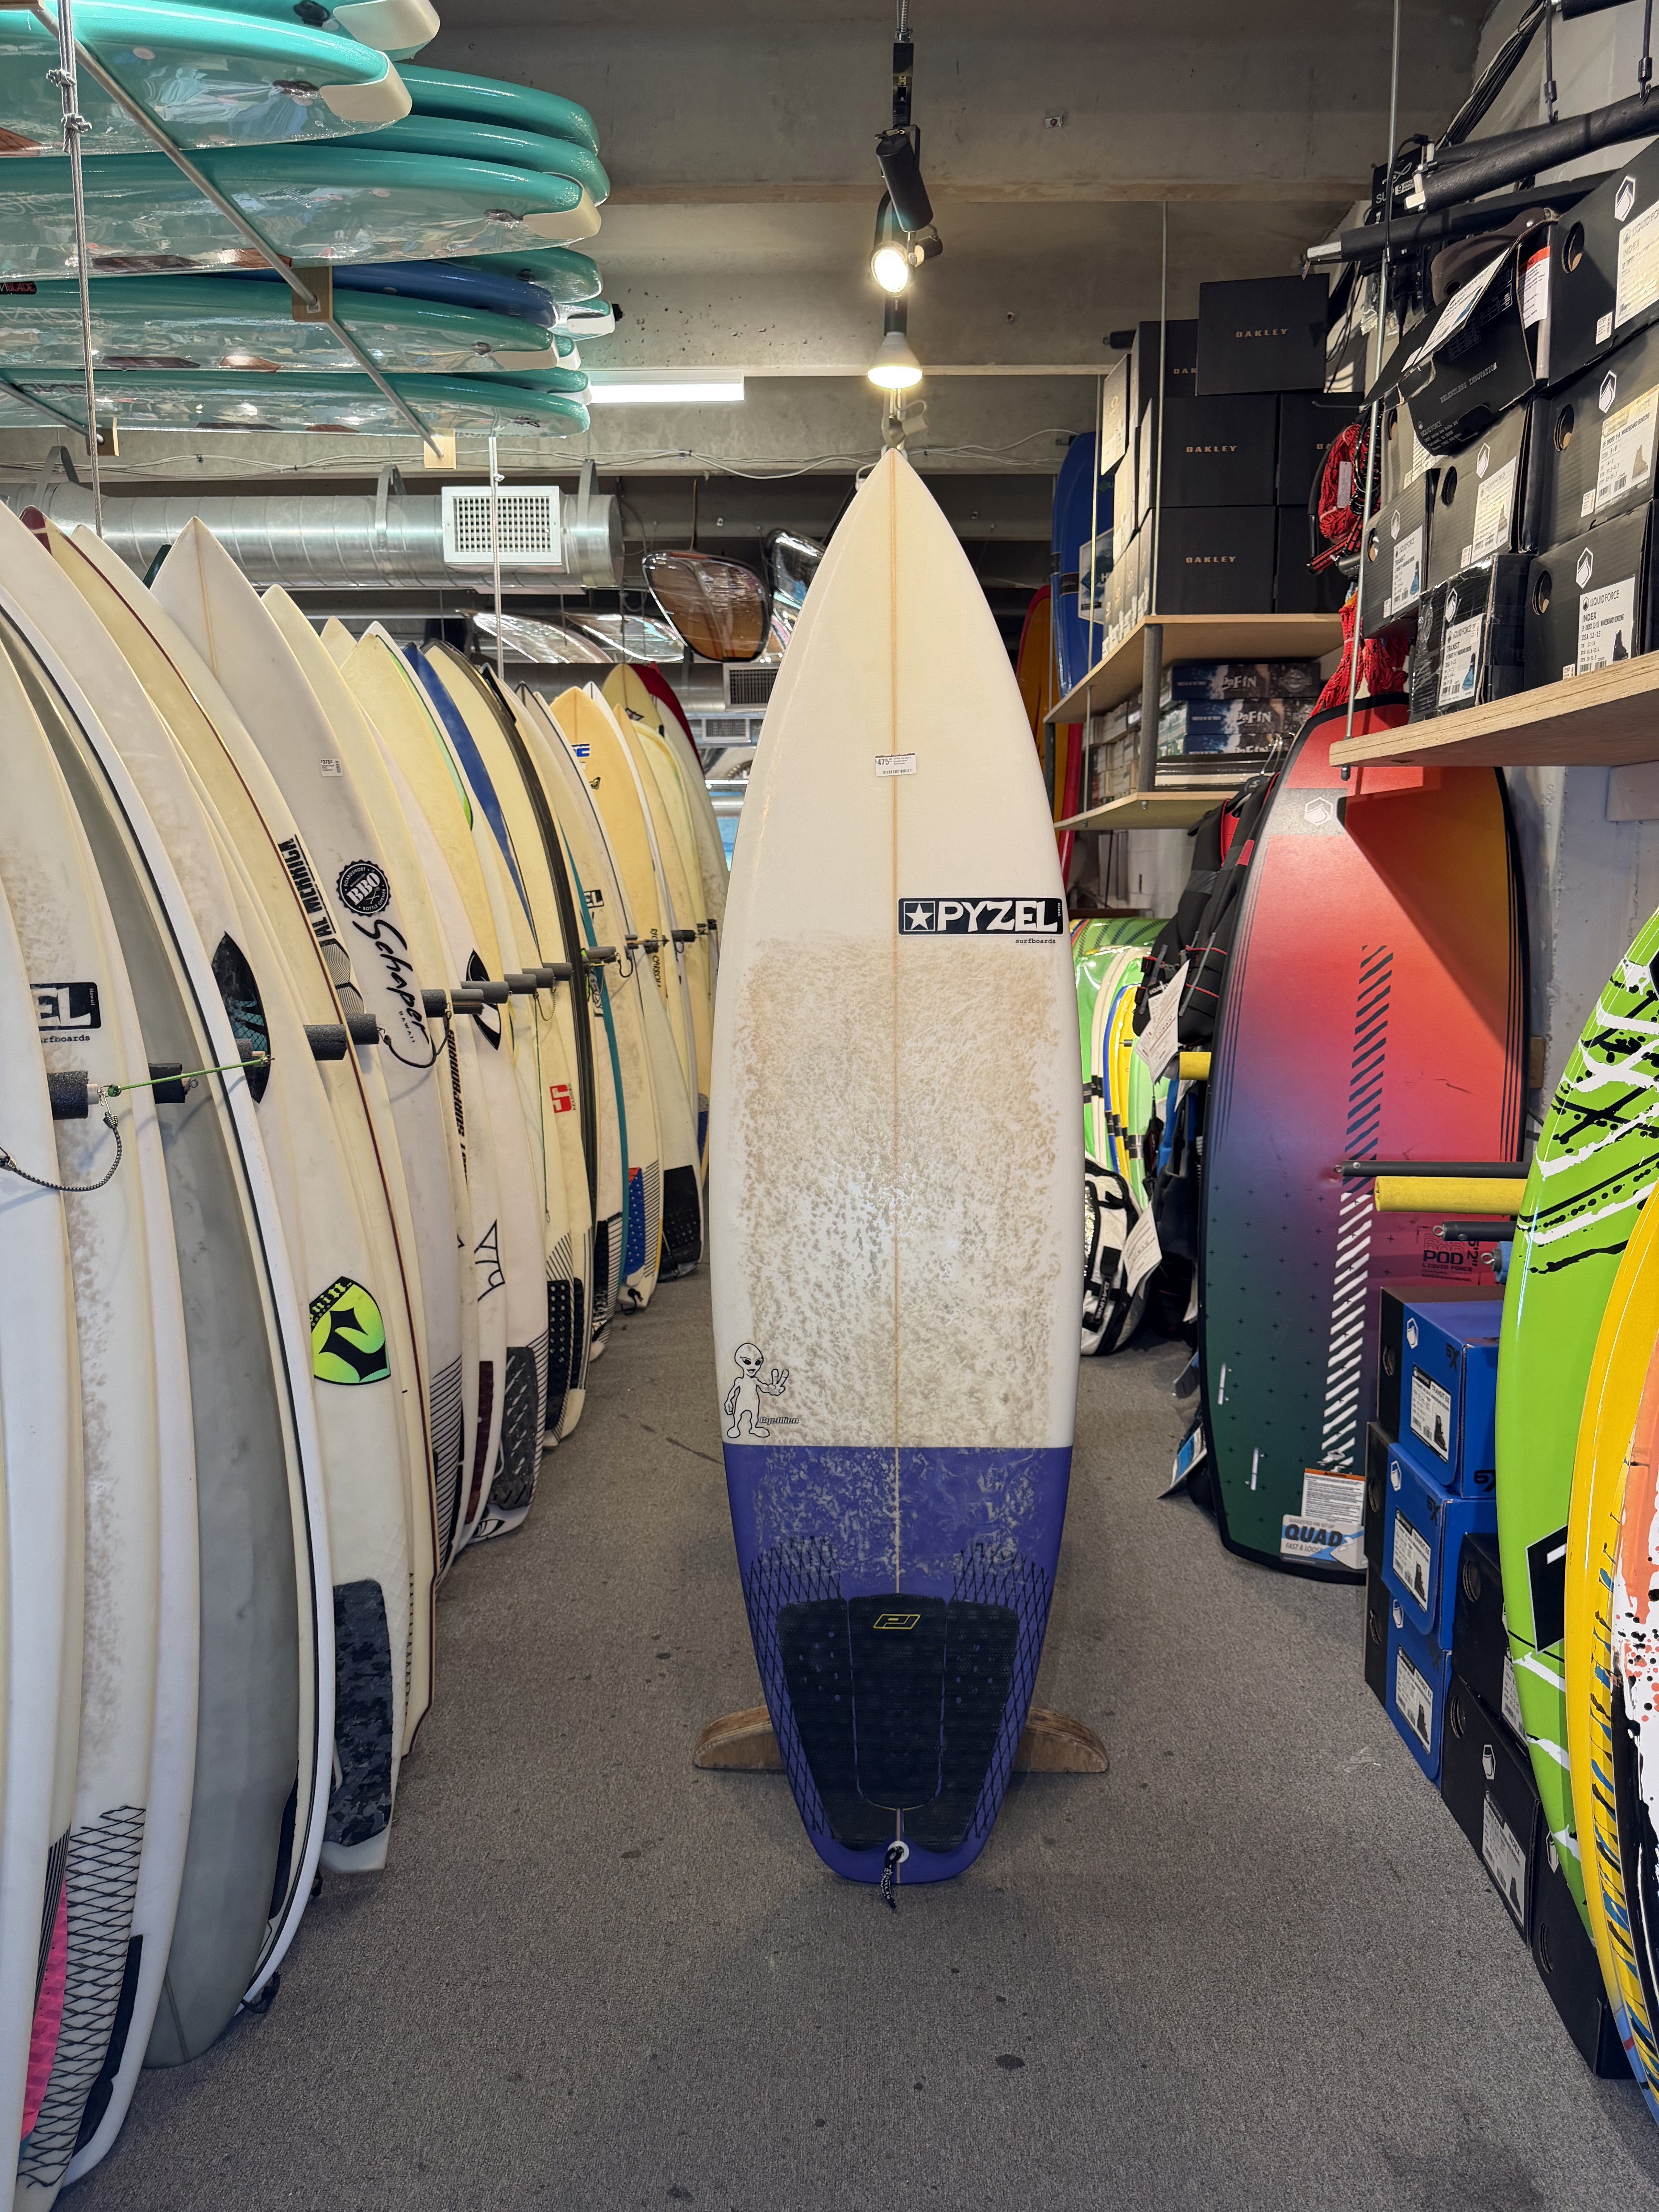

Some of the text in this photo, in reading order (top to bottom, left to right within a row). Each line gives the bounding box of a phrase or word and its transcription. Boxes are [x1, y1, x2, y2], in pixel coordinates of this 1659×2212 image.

[1623, 238, 1640, 258] INDEX
[1235, 328, 1289, 338] OAKLEY
[1469, 362, 1497, 385] INNOVATION
[1440, 382, 1467, 403] RELENTLESS
[1590, 590, 1620, 607] LIQUID FORCE
[1582, 611, 1597, 623] INDEX
[1601, 617, 1614, 627] WAKEBOARD
[1590, 630, 1601, 639] 12-15
[344, 867, 366, 887] BOARDSHORT
[278, 838, 333, 938] AL MERRICK
[346, 872, 380, 905] BBO
[378, 888, 386, 905] OPENER
[937, 900, 1058, 932] PYZEL
[352, 919, 429, 1044] Schaper
[398, 1010, 416, 1043] HAWAII
[447, 1029, 465, 1137] SURFBOARDS
[1423, 1250, 1463, 1265] POD
[1095, 1281, 1109, 1320] DAKINE
[1289, 1518, 1312, 1526] SUGGESTED
[1285, 1524, 1343, 1547] QUAD
[1508, 1832, 1520, 1856] INDEX
